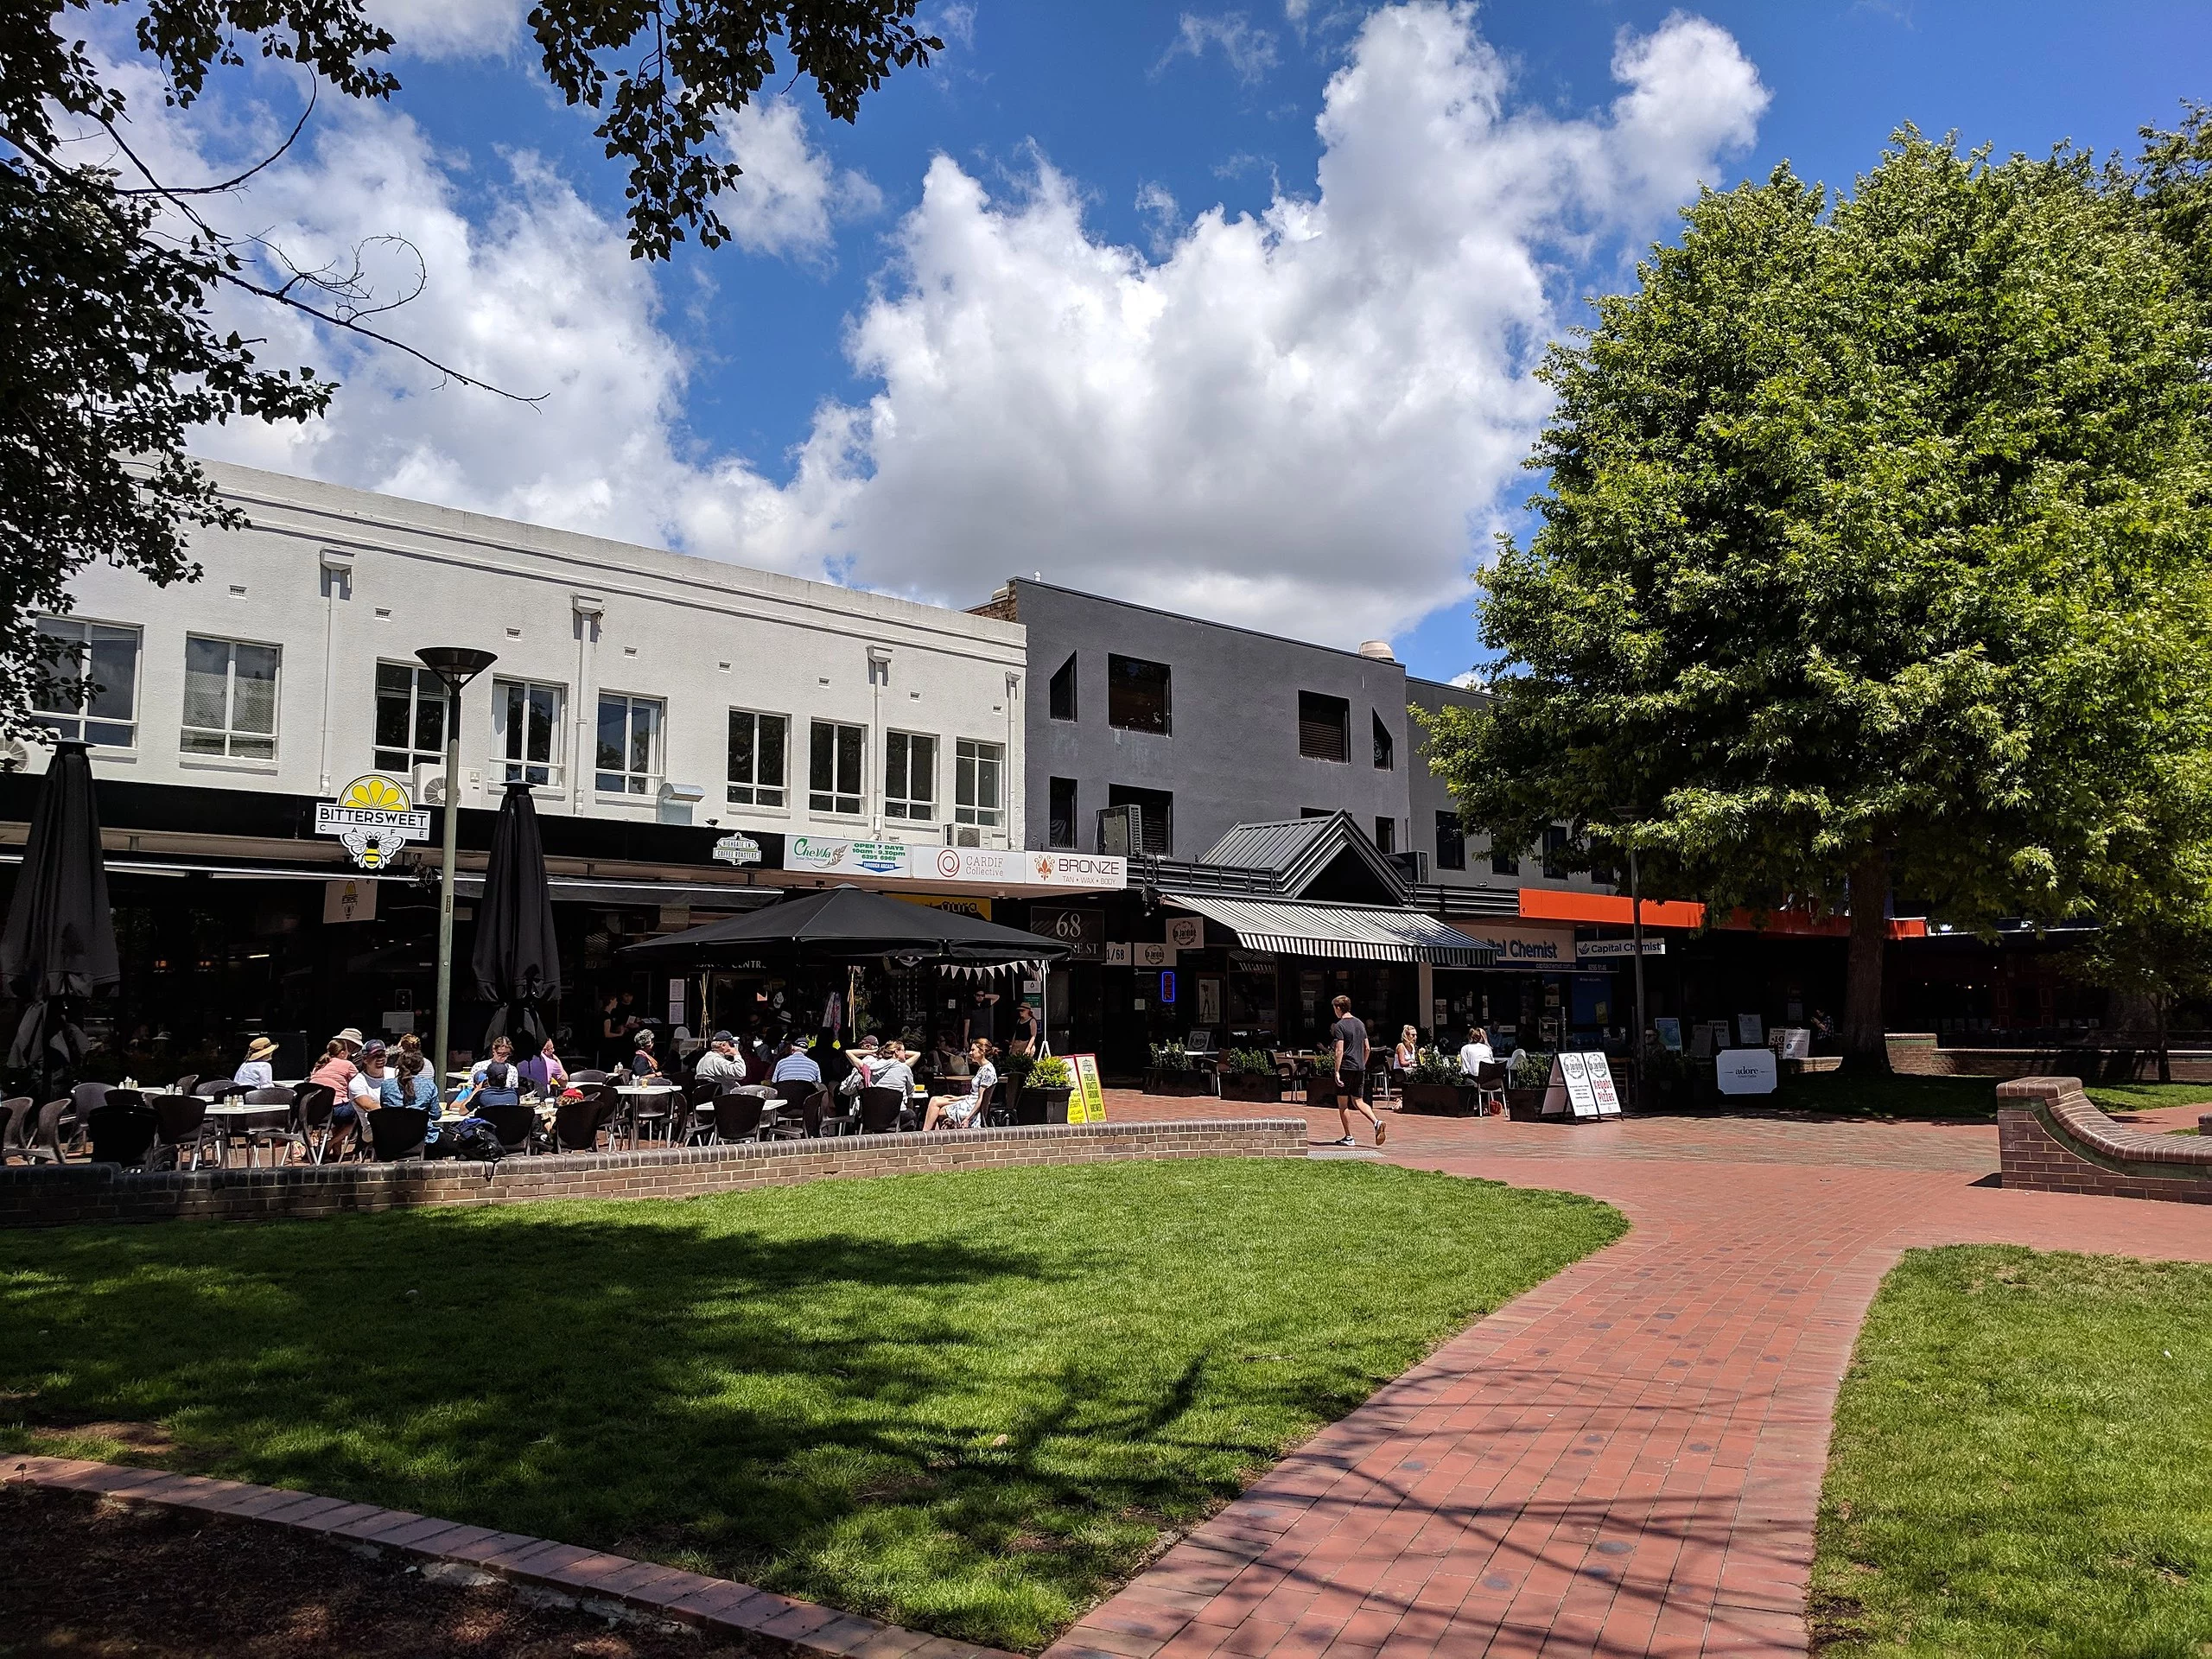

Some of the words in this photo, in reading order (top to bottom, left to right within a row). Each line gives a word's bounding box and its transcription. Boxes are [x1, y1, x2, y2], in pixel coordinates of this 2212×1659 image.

[320, 808, 427, 827] BITTERSWEET
[319, 824, 424, 838] CAFÉ
[965, 855, 1004, 868] CARDIF
[1058, 858, 1120, 875] BRONZE
[965, 867, 1004, 877] Collective
[1056, 911, 1081, 938] 68
[1086, 944, 1099, 954] ST
[1510, 939, 1558, 959] Chemist
[1591, 943, 1622, 954] Capital
[1624, 942, 1661, 951] Chmist
[1735, 1066, 1758, 1075] adore
[1592, 1079, 1612, 1090] Kebabs
[1597, 1090, 1615, 1103] Pizzas
